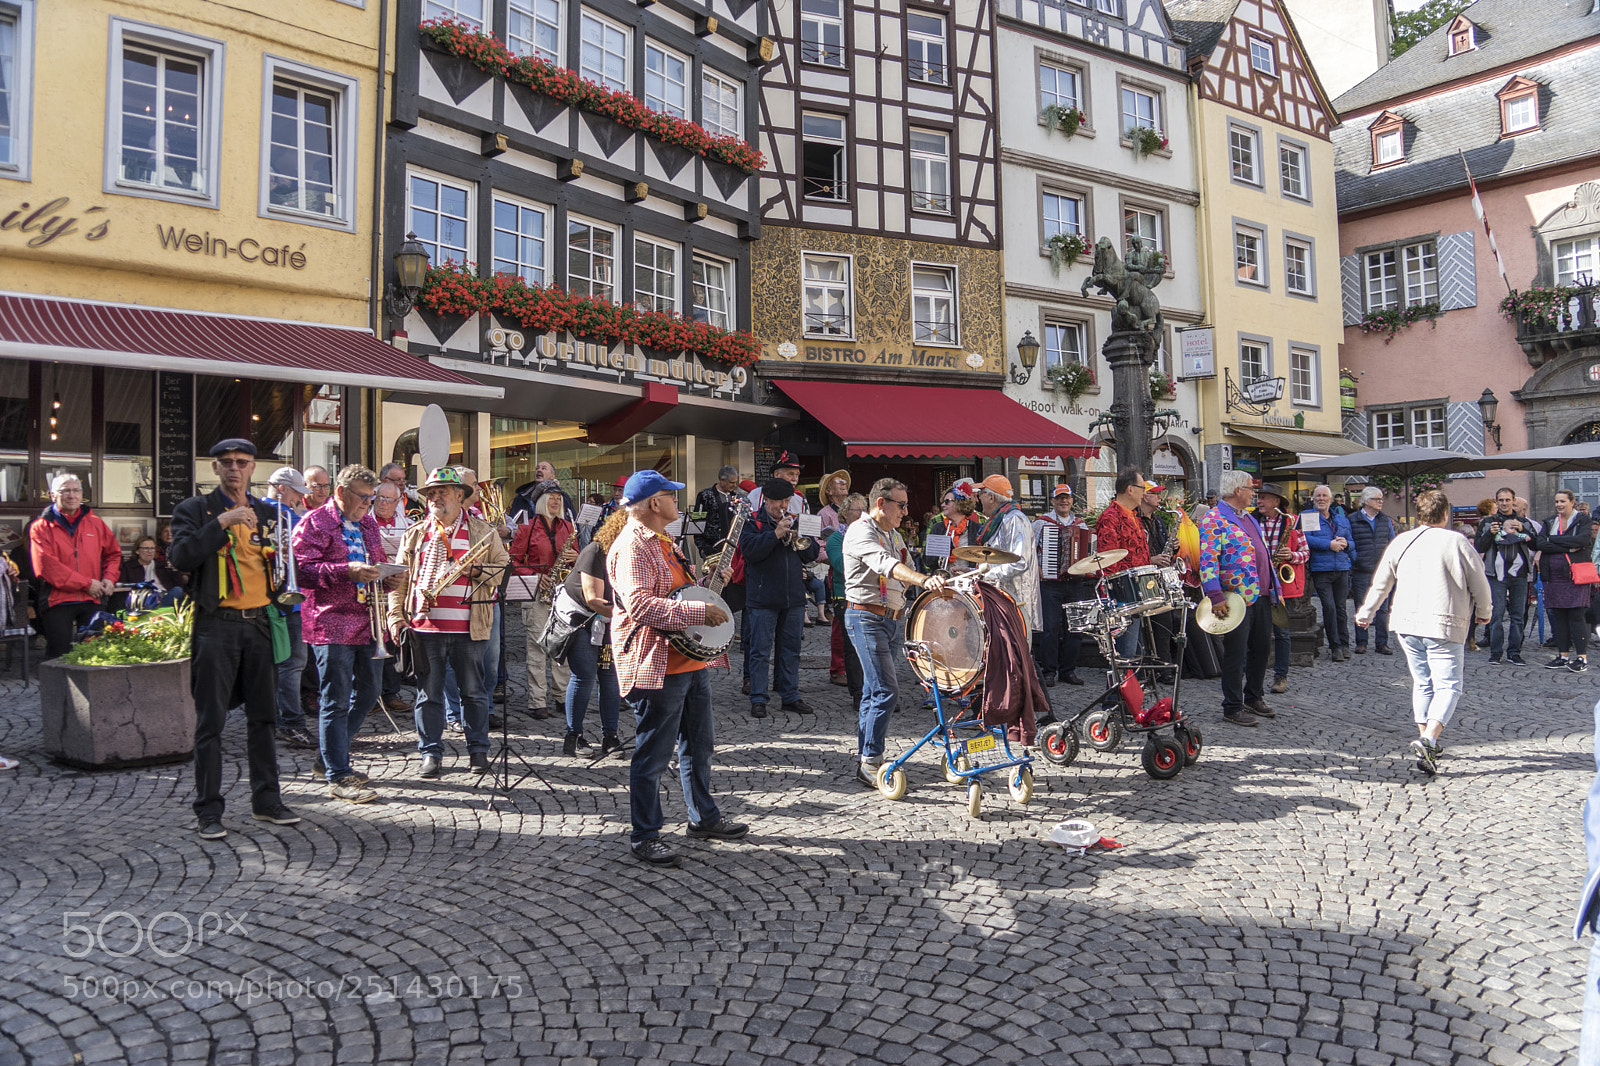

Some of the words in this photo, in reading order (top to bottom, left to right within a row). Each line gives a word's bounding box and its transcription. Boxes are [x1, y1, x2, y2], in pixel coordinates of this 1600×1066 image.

[157, 223, 307, 270] Wein-Café
[536, 334, 640, 372] brillen
[648, 357, 728, 386] müller
[806, 346, 866, 363] BISTRO
[873, 349, 905, 364] Am
[908, 350, 959, 368] Markt
[1166, 419, 1188, 428] ARKT
